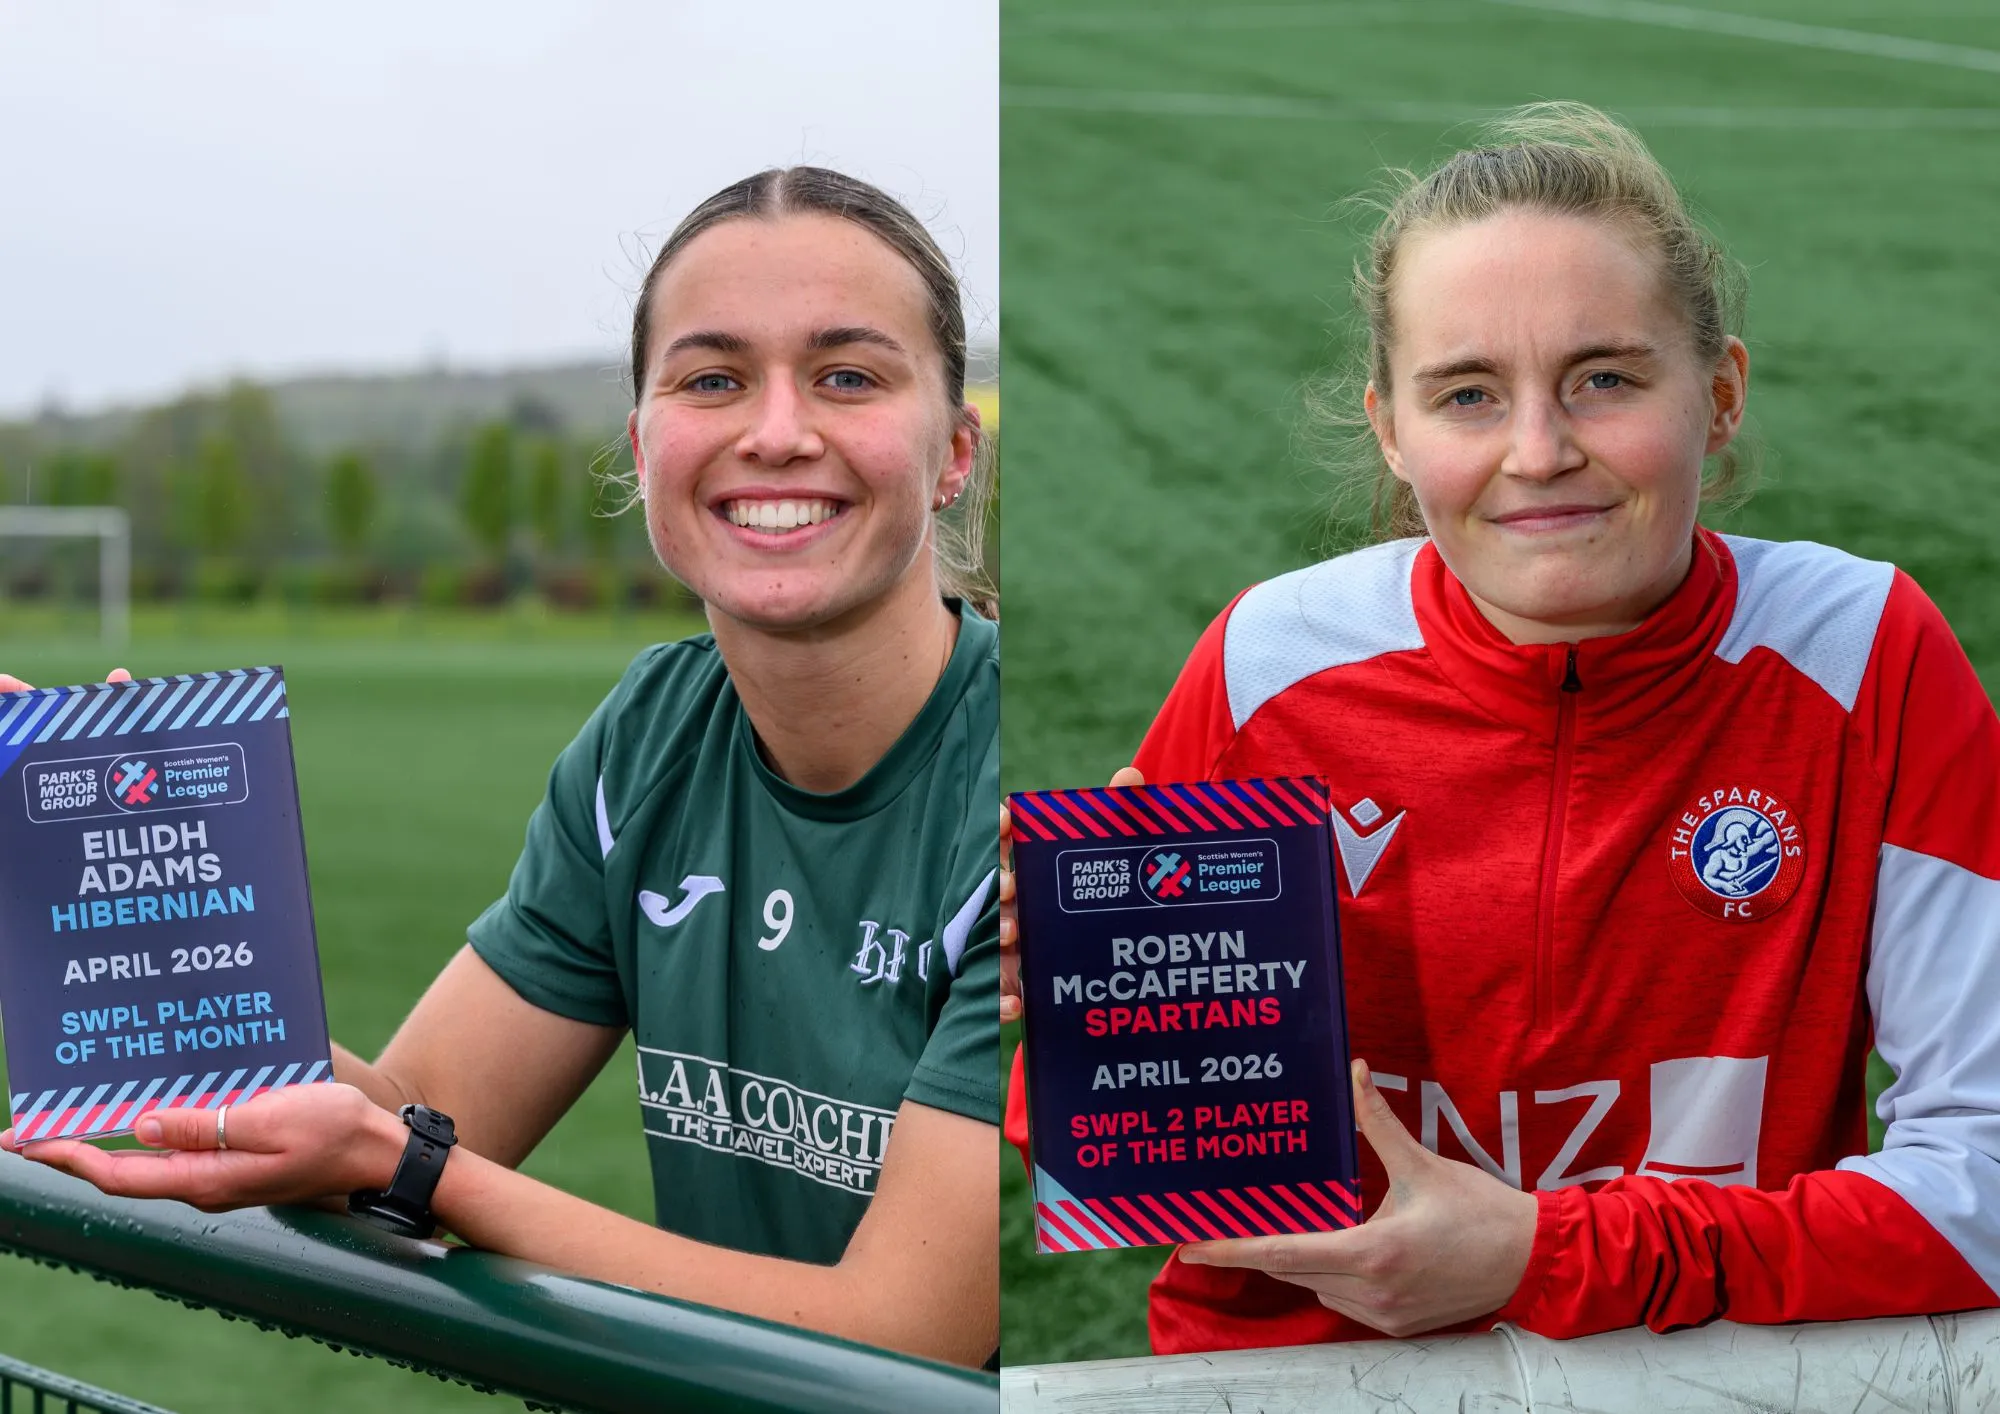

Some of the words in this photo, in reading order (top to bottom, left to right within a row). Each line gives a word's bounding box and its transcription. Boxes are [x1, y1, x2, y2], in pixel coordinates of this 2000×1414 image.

[39, 769, 96, 786] PARK'S
[164, 757, 195, 768] Scottish
[196, 755, 229, 765] Women's
[165, 764, 230, 783] Premier
[40, 781, 97, 799] MOTOR
[41, 795, 97, 811] GROUP
[167, 781, 228, 799] League
[83, 820, 208, 861] EILIDH
[1672, 811, 1699, 860] THE
[1698, 787, 1801, 857] SPARTANS
[79, 853, 222, 895] ADAMS
[1072, 859, 1130, 875] PARK'S
[1198, 853, 1229, 861] Scottish
[1230, 851, 1264, 859] Women's
[1198, 861, 1264, 877] Premier
[1072, 872, 1131, 887] MOTOR
[1073, 885, 1130, 900] GROUP
[1199, 877, 1262, 895] League
[51, 885, 255, 932] HIBERNIAN
[758, 889, 794, 951] 9
[1724, 901, 1752, 918] FC
[64, 952, 160, 985] APRIL
[171, 942, 254, 974] 2026
[1112, 930, 1247, 967] ROBYN
[1053, 960, 1307, 1004] McCAFFERTY
[62, 1005, 148, 1035] SWPL
[158, 991, 274, 1025] PLAYER
[1085, 997, 1281, 1037] SPARTANS
[55, 1040, 97, 1065] OF
[106, 1032, 165, 1059] THE
[174, 1019, 286, 1052] MONTH
[1092, 1059, 1190, 1090] APRIL
[1200, 1053, 1283, 1083] 2026
[1071, 1111, 1157, 1139] SWPL
[1167, 1108, 1185, 1131] 2
[1195, 1100, 1310, 1130] PLAYER
[667, 1112, 709, 1141] THE
[794, 1146, 872, 1188] EXPERT
[1077, 1143, 1118, 1168] OF
[1128, 1137, 1187, 1164] THE
[1196, 1129, 1308, 1159] MONTH
